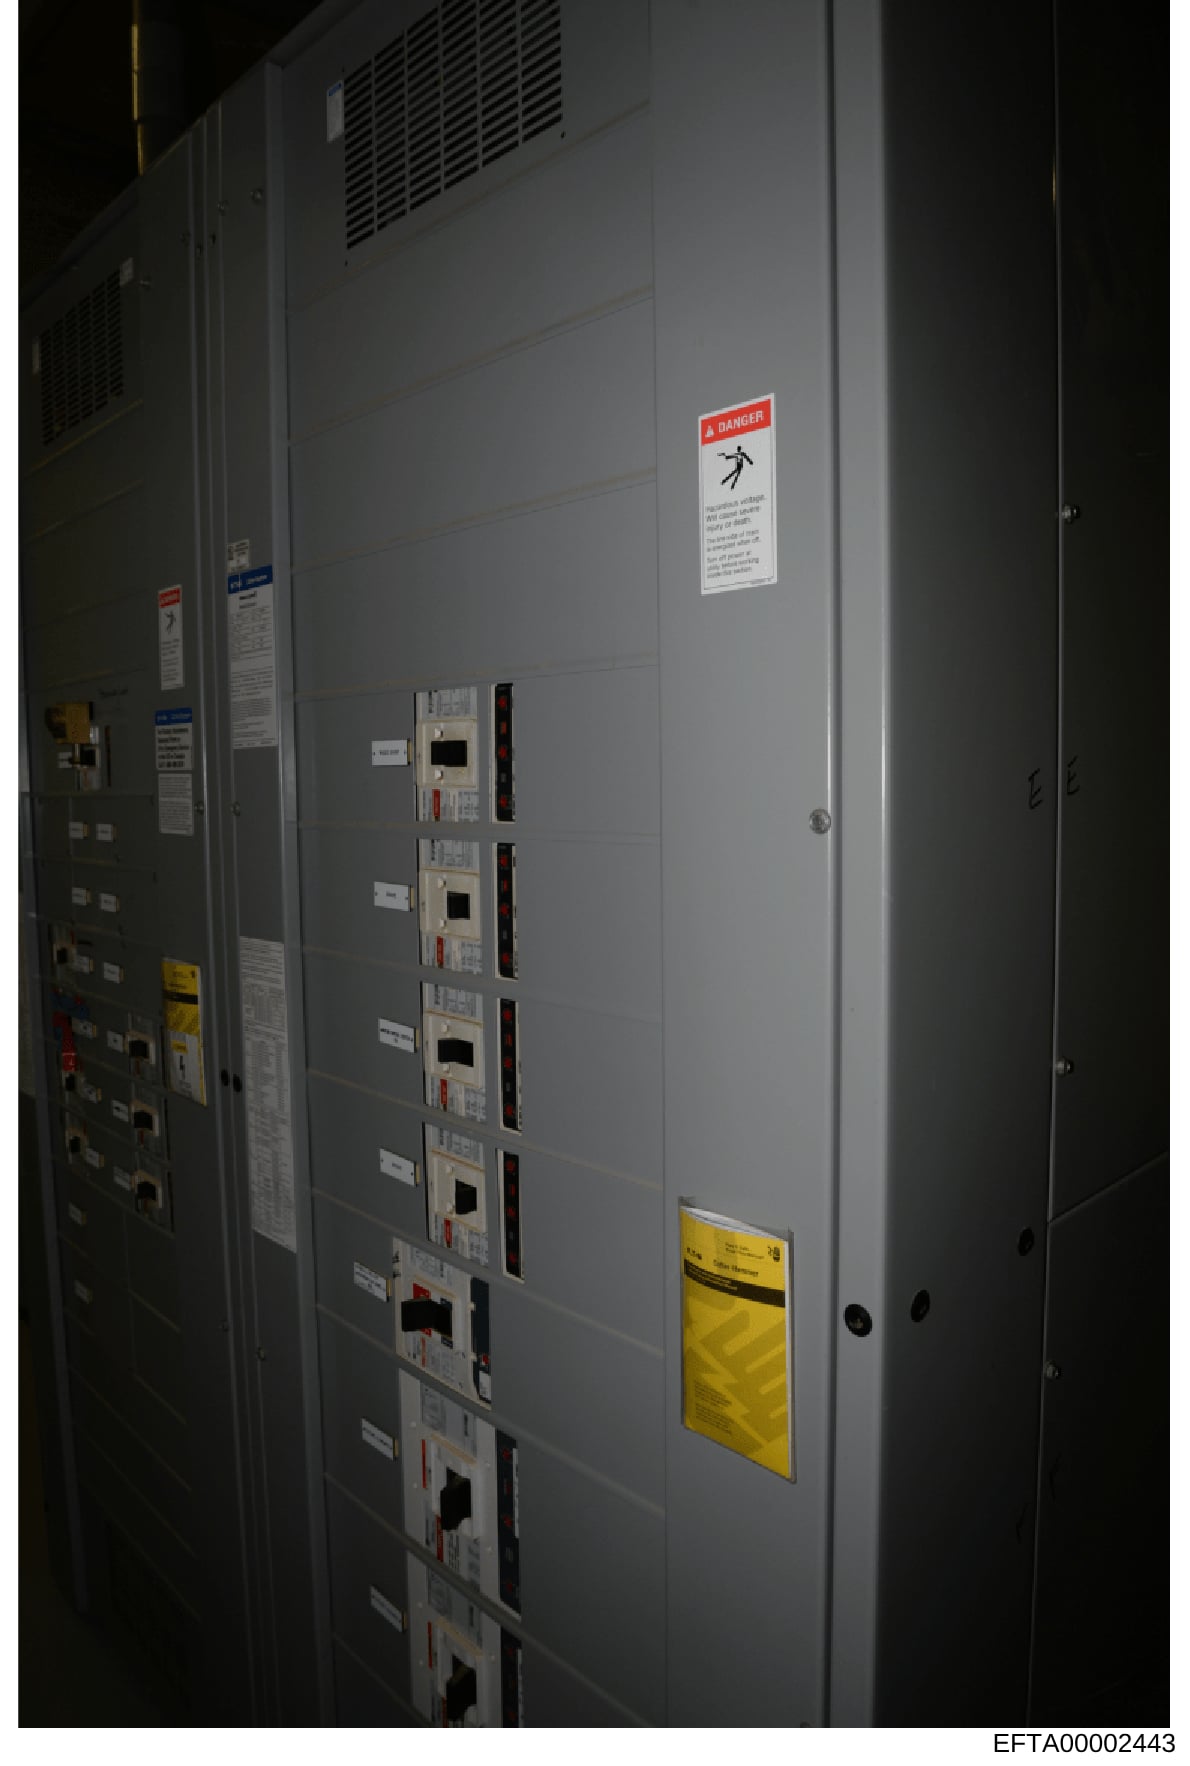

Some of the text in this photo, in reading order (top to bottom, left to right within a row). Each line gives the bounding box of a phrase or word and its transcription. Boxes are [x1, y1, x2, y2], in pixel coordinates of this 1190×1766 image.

[718, 410, 764, 433] DANGER
[1028, 768, 1043, 809] E
[1067, 755, 1080, 795] E
